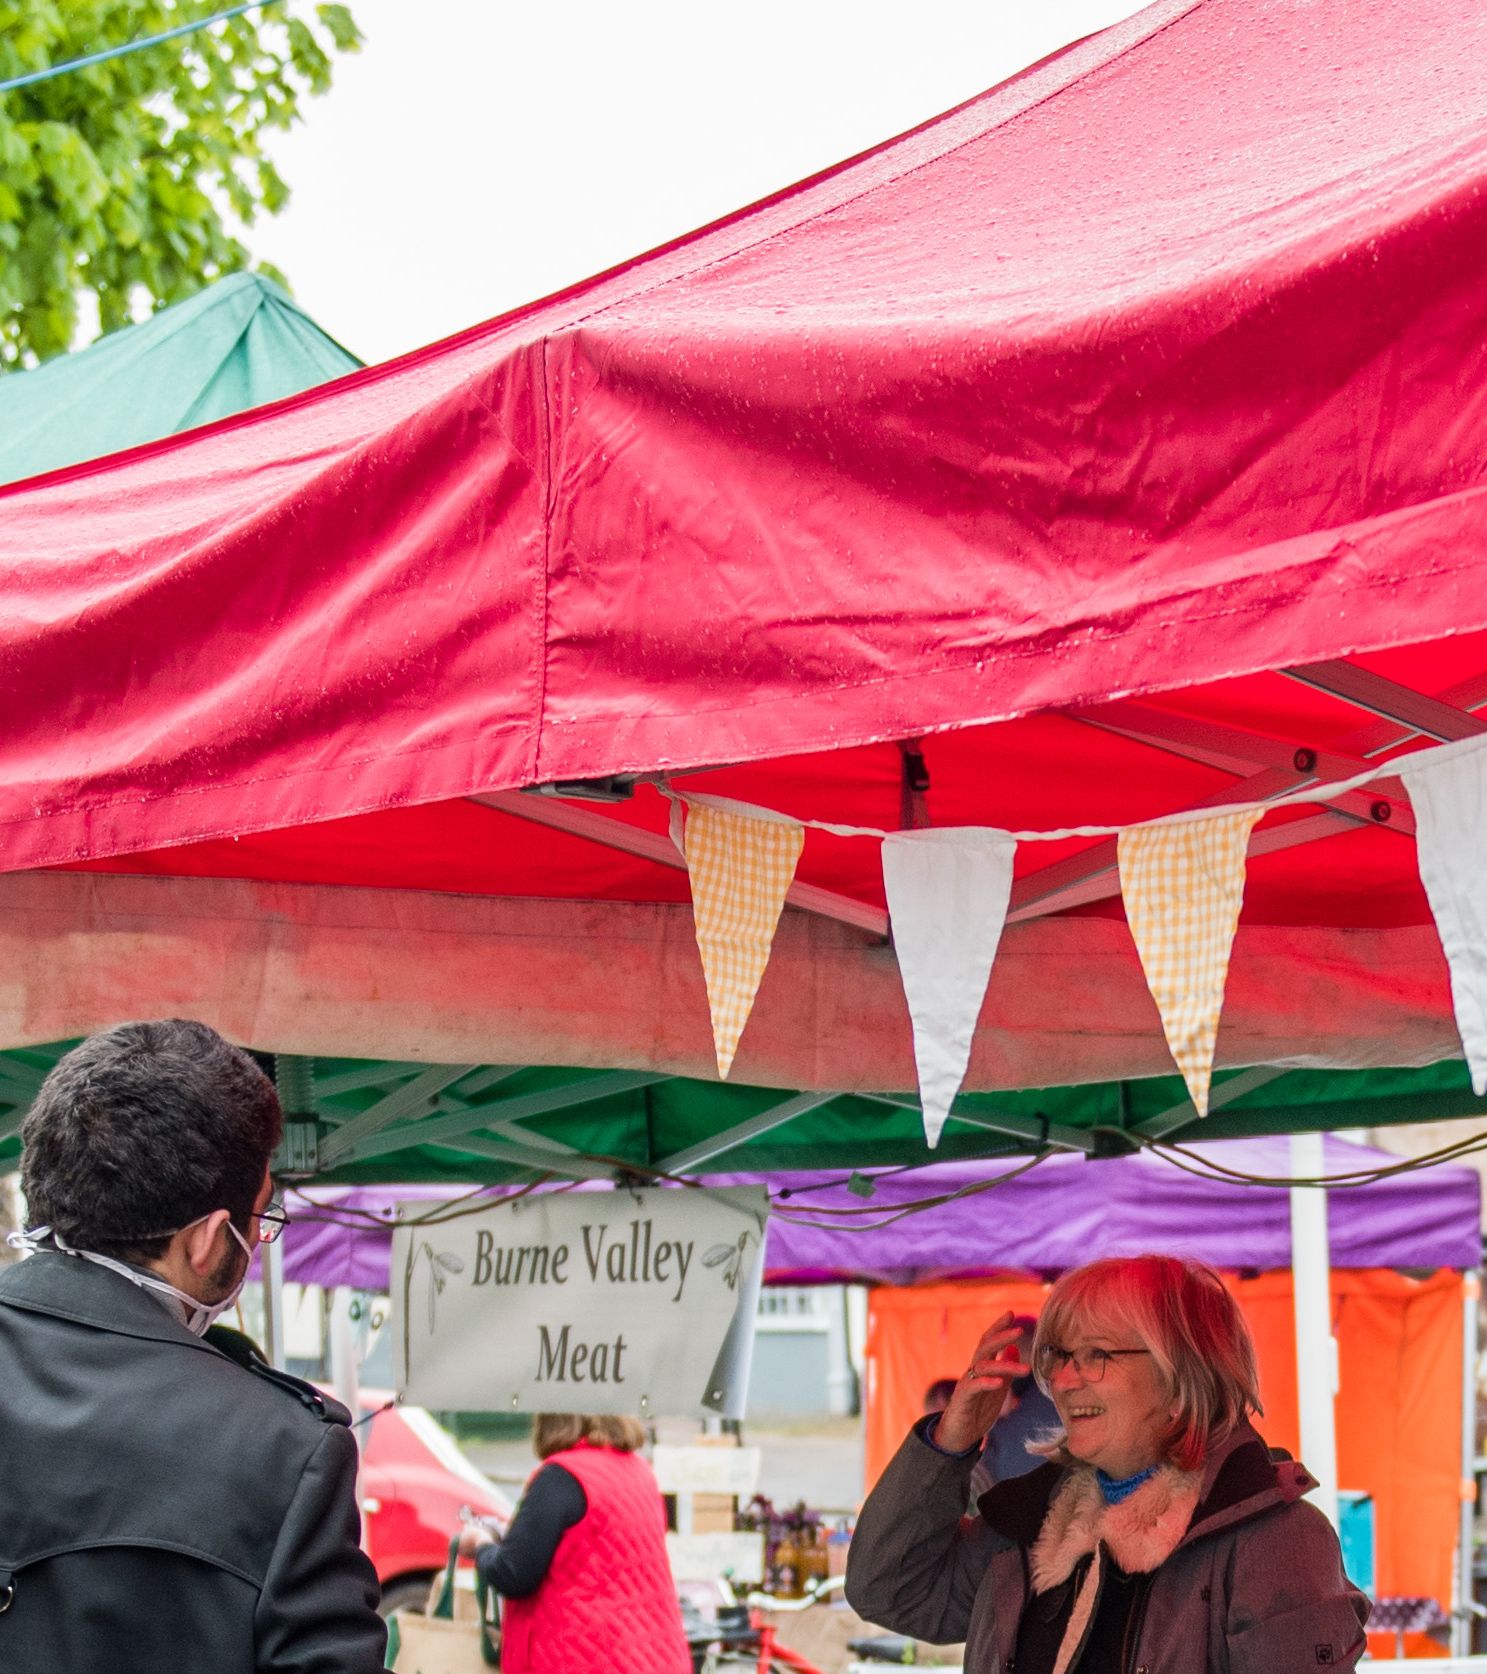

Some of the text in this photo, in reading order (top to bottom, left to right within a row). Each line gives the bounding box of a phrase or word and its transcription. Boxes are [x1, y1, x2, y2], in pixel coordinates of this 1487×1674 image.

[472, 1220, 695, 1302] Burne Valley
[534, 1325, 627, 1384] Meat
